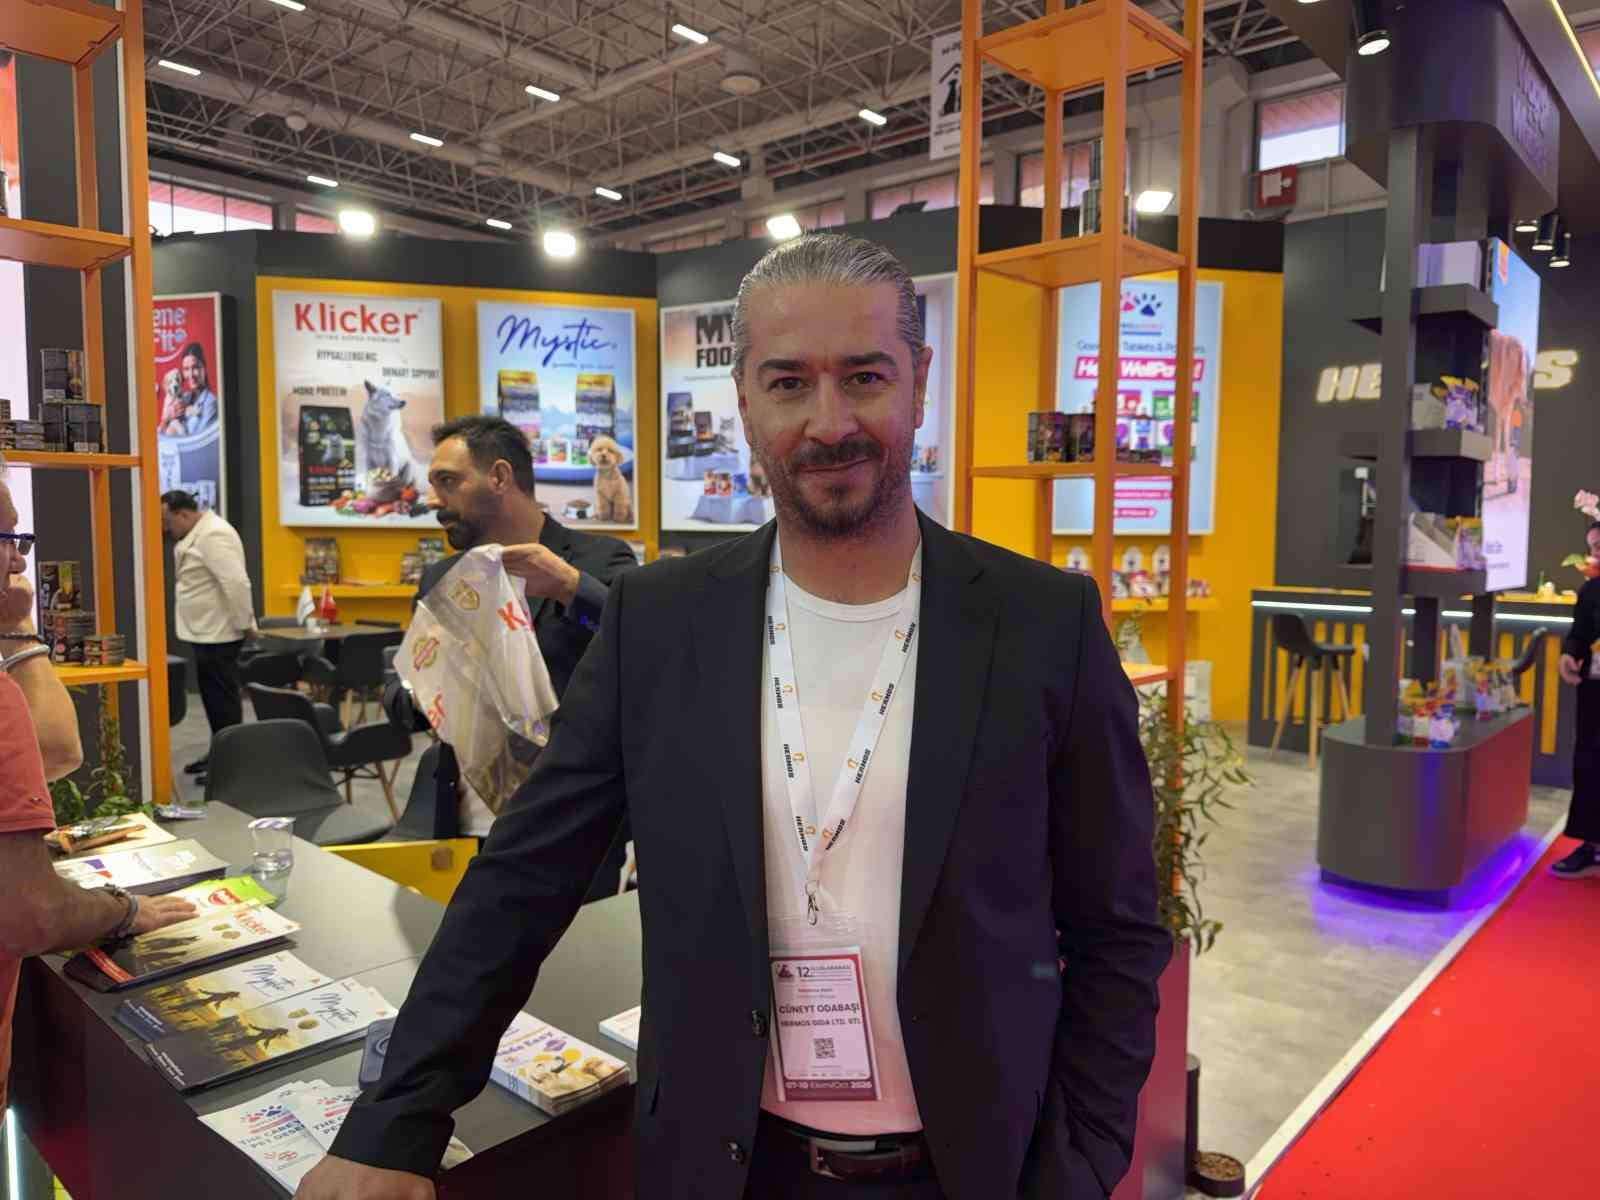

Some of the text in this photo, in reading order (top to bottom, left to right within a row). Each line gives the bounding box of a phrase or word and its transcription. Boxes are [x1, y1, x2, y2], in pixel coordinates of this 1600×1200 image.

[294, 302, 419, 335] Klicker
[497, 314, 608, 368] Mystic
[696, 347, 735, 368] FOO
[778, 1004, 815, 1015] CÜNEYT
